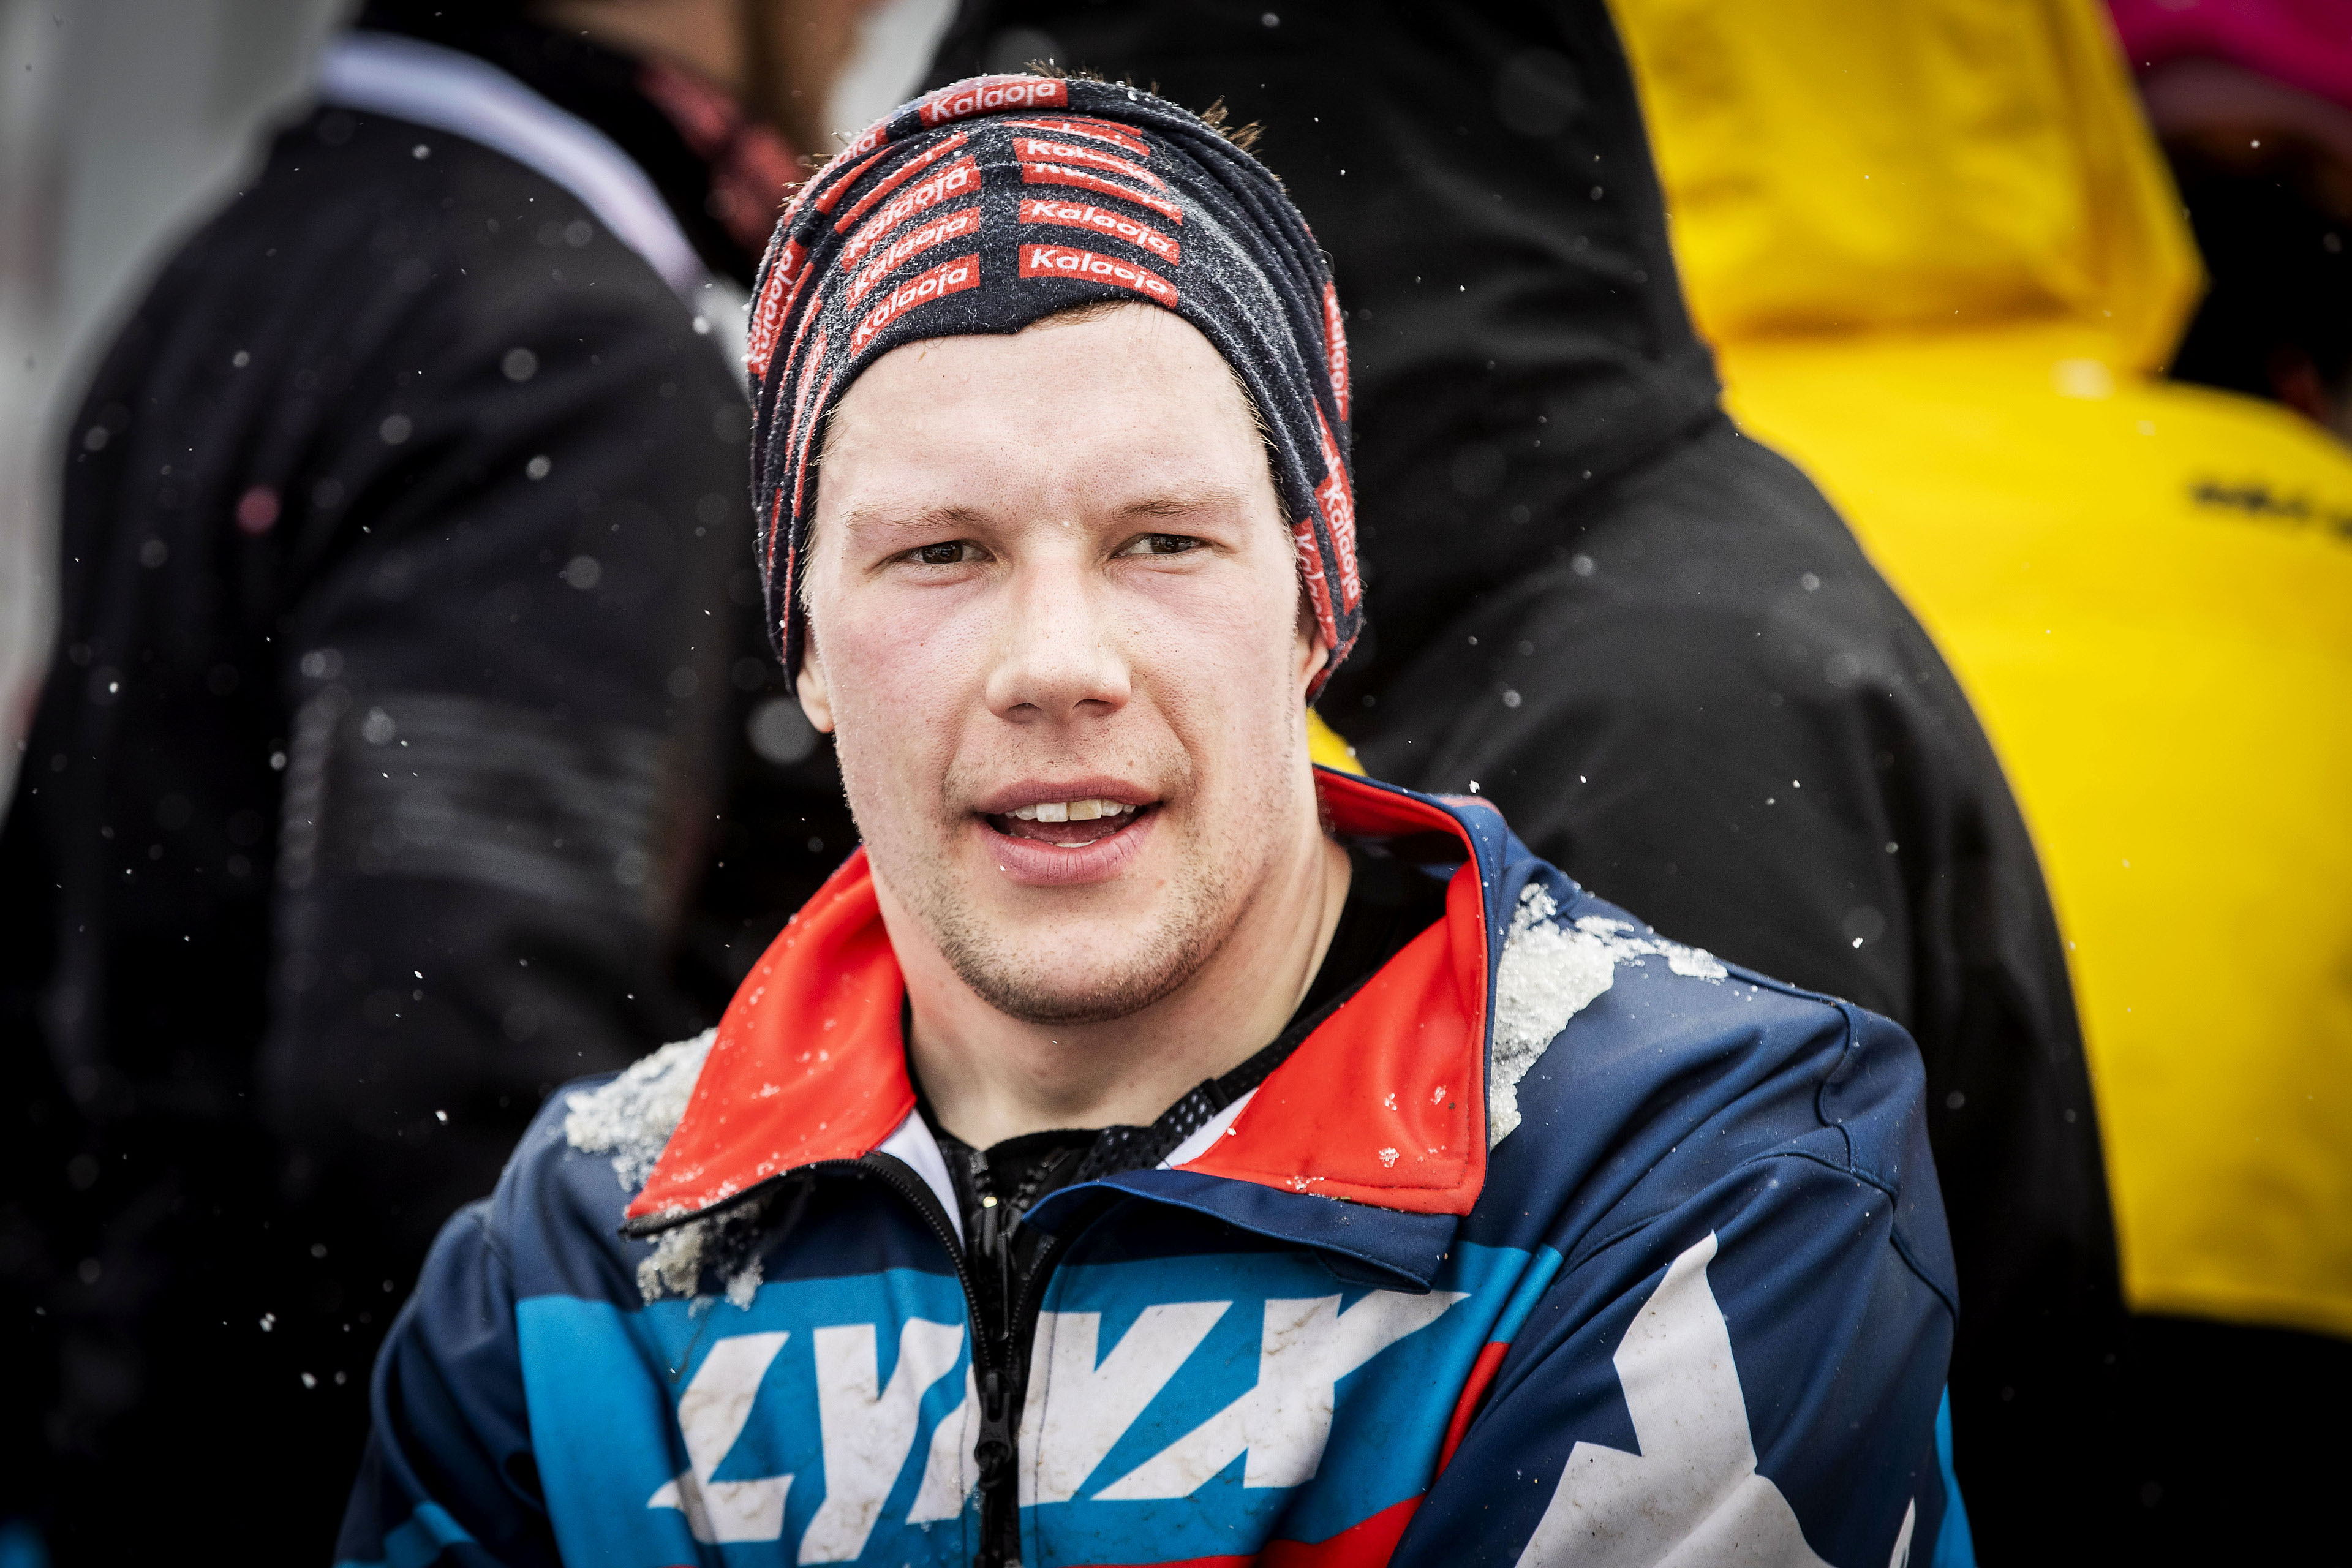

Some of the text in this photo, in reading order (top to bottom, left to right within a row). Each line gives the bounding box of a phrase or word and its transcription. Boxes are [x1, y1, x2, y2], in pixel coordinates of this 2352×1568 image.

[930, 83, 1056, 122] Kalaoja
[854, 216, 968, 298] Kalaoja
[1031, 202, 1173, 252] Kalaoja
[1030, 249, 1167, 293] Kalaoja
[857, 266, 968, 345] Kalaoja
[647, 1289, 1472, 1567] LYNX
